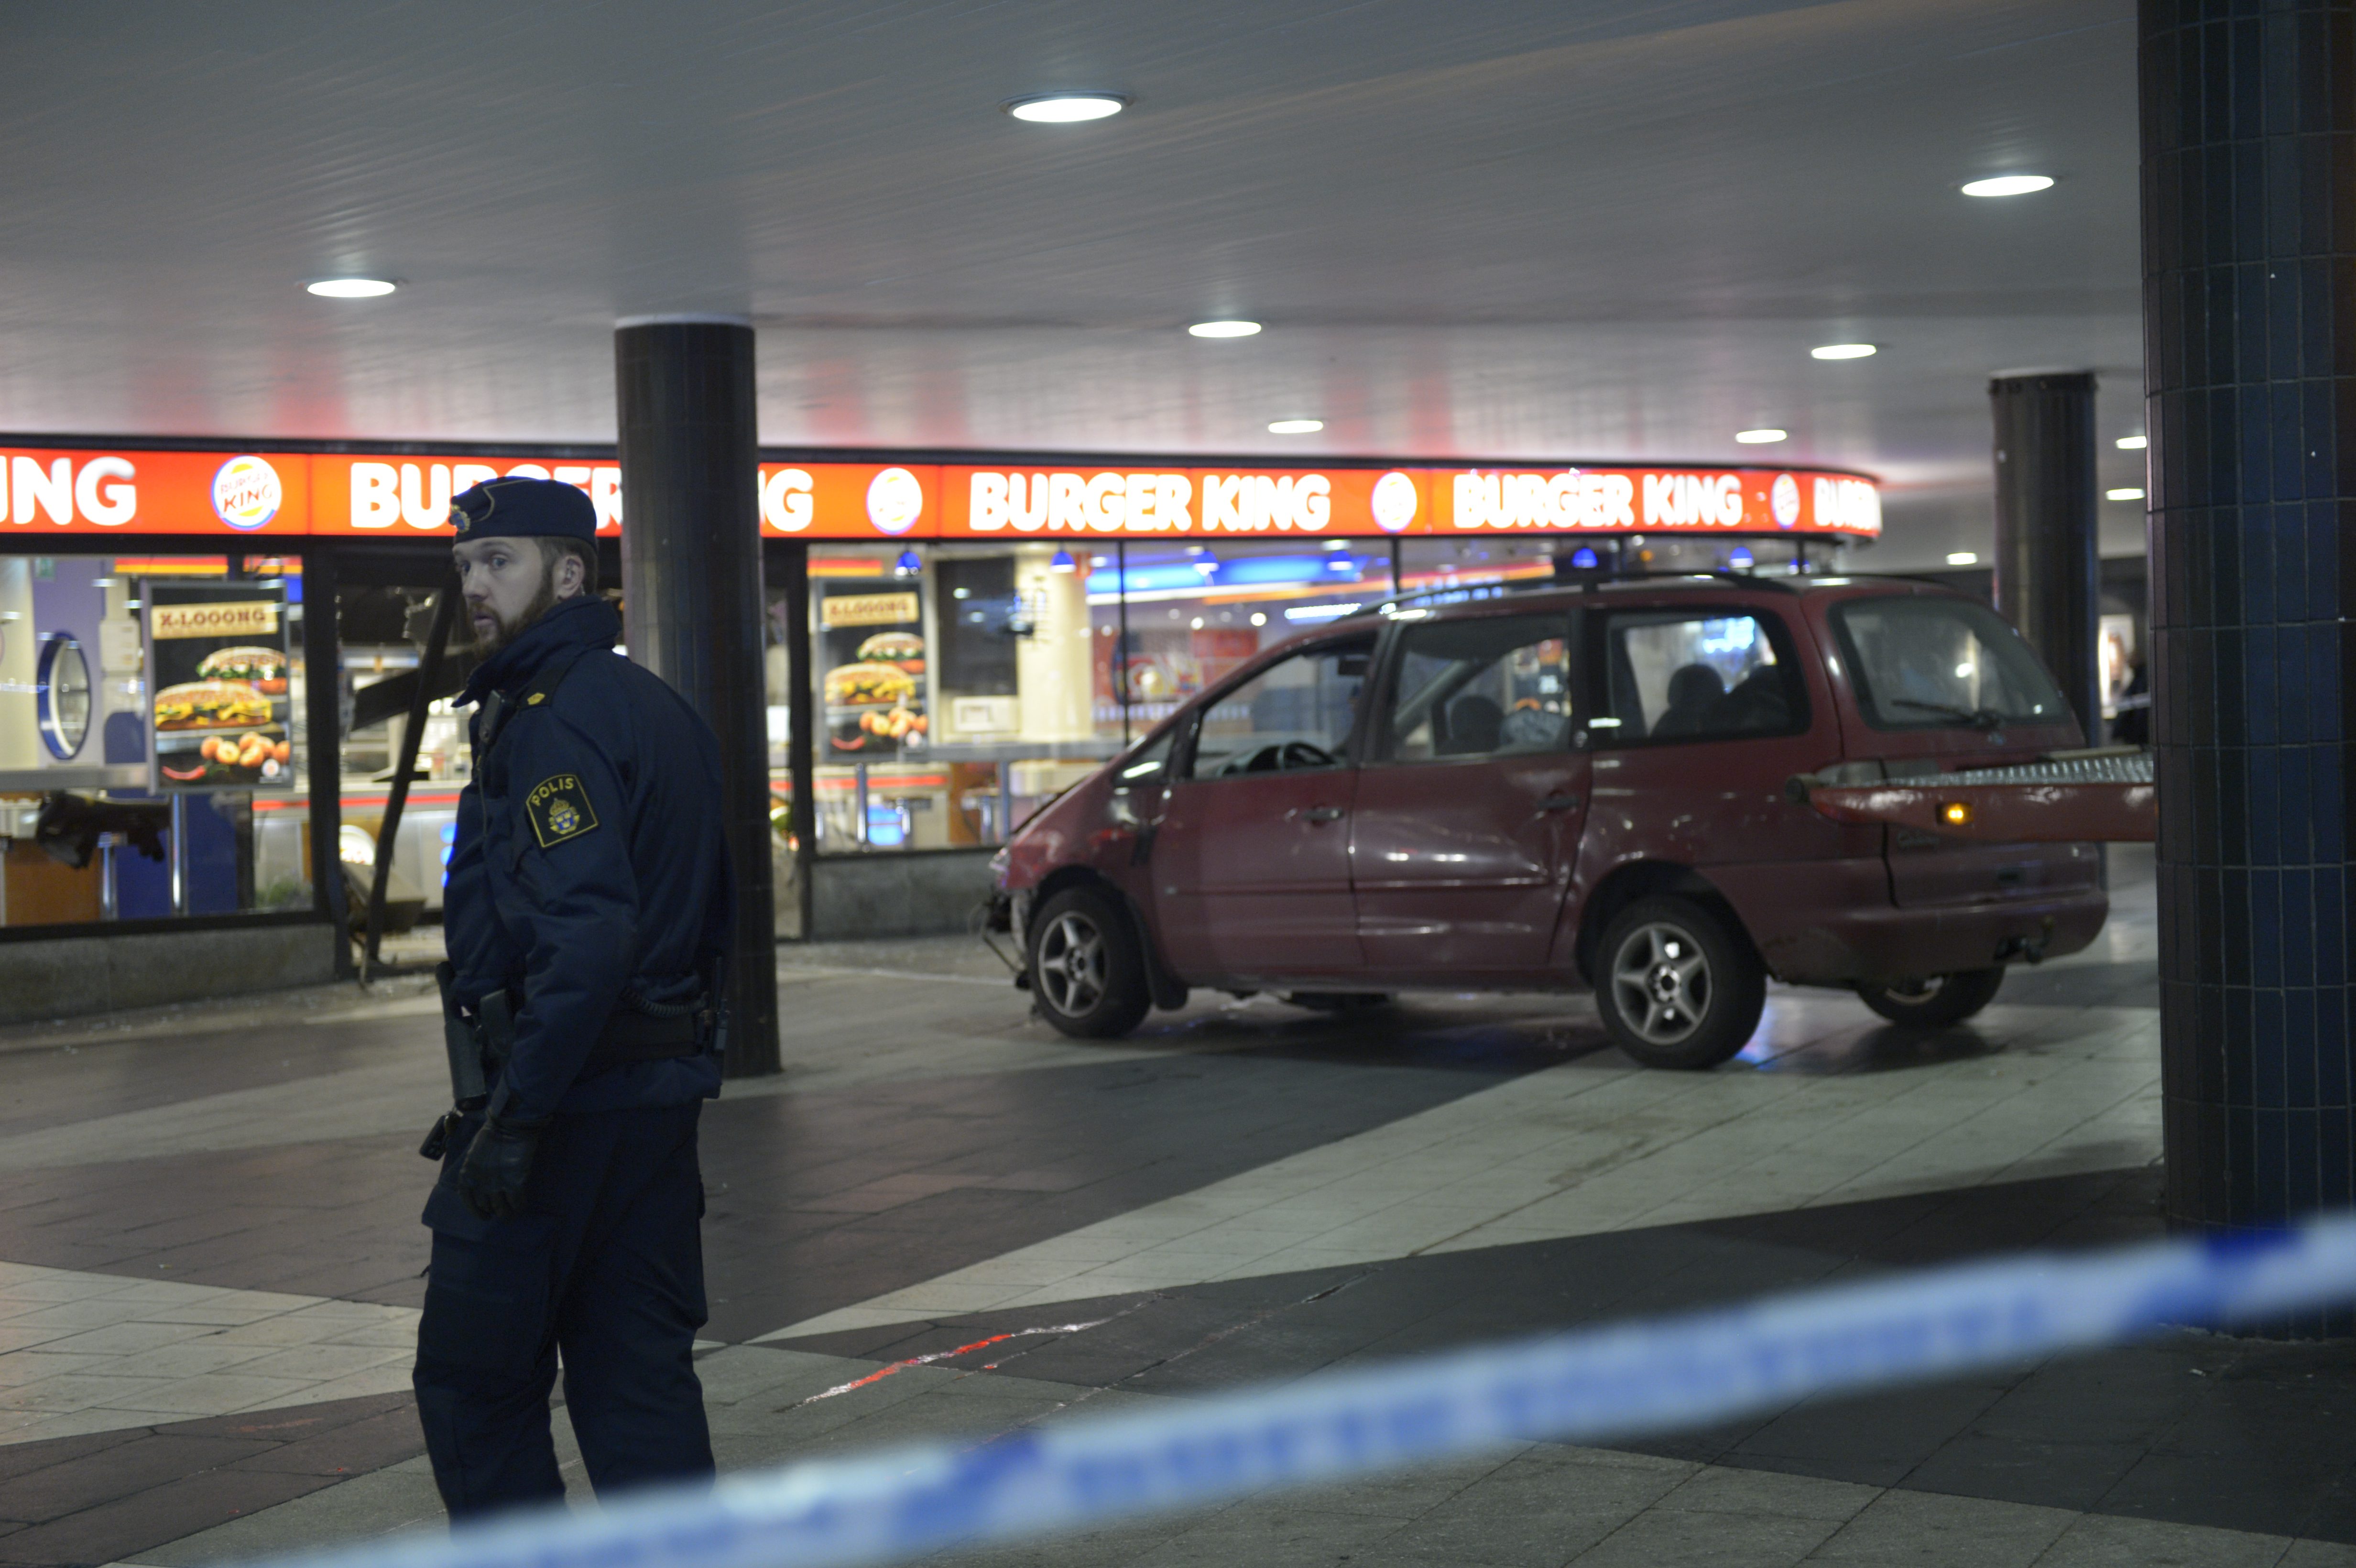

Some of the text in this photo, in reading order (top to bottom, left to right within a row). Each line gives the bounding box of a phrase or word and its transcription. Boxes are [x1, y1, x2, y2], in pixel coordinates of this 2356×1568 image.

[223, 484, 273, 513] KING
[969, 472, 1192, 532] BURGER
[1202, 474, 1331, 532] KING
[1453, 473, 1635, 529] BURGER
[1643, 474, 1743, 526] KING
[530, 777, 574, 807] POLIS
